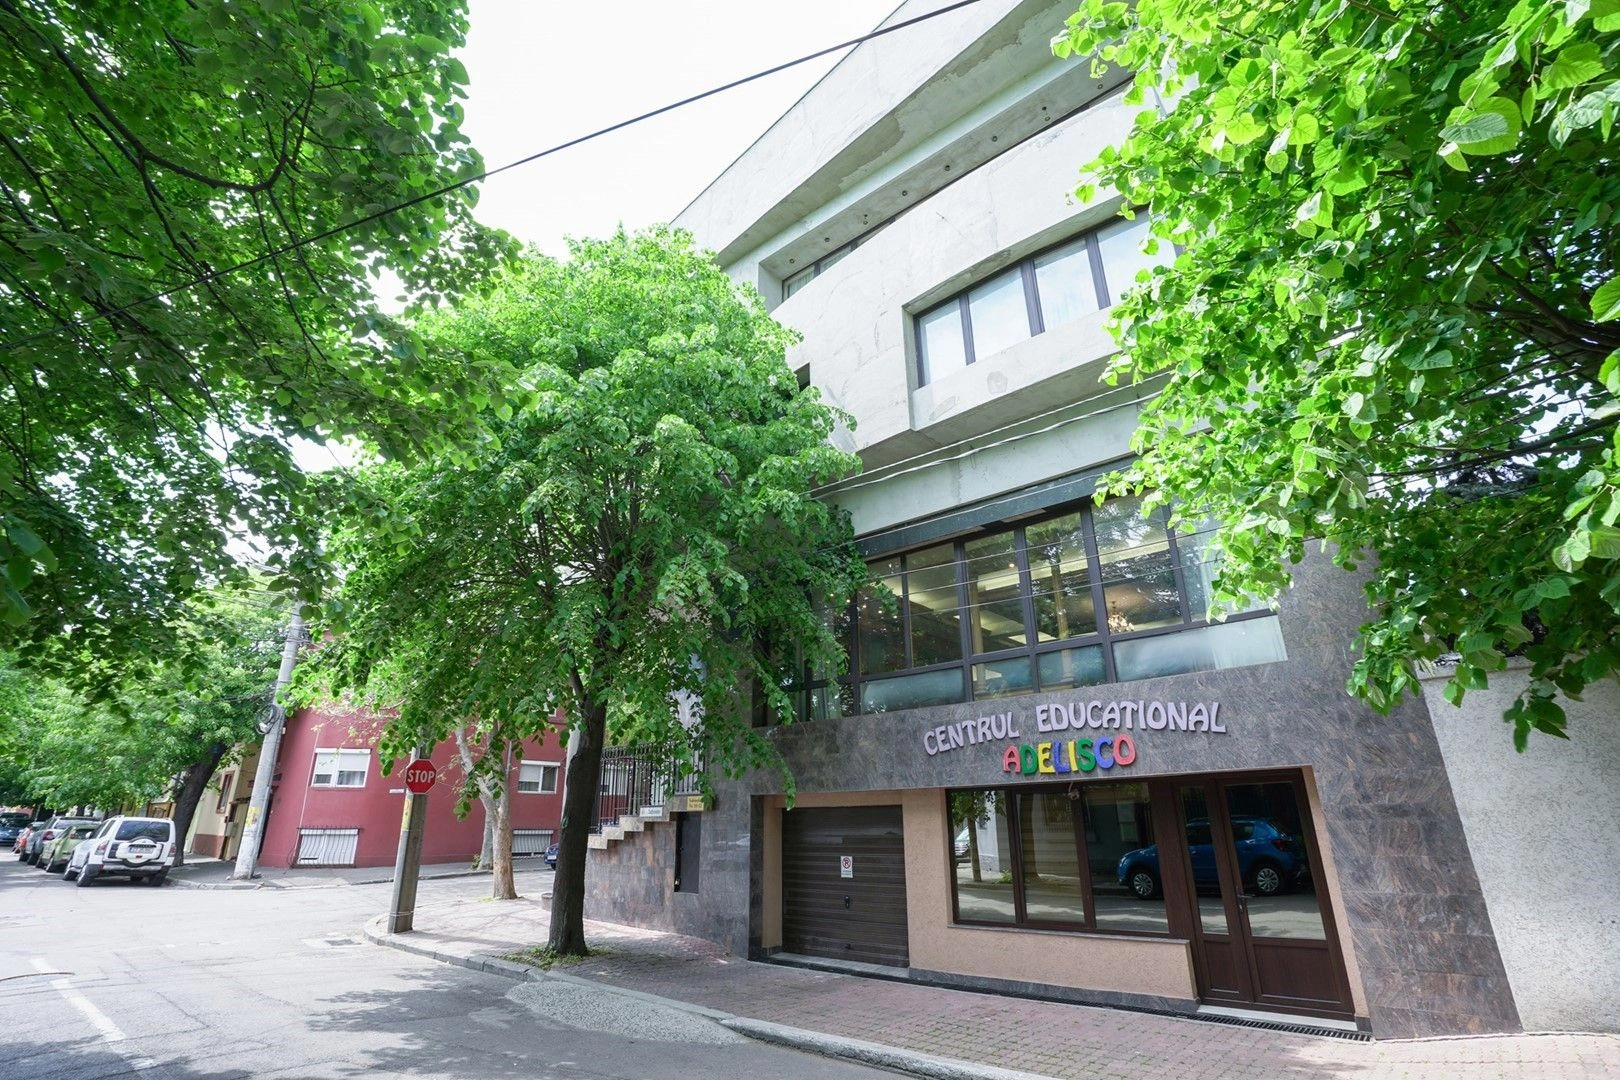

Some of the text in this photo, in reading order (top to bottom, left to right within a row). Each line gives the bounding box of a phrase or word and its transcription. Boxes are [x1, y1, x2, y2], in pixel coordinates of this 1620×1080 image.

[924, 701, 1227, 756] CENTRUL EDUCATIONAL
[1003, 733, 1136, 775] ADELISCO
[407, 770, 435, 783] STOP
